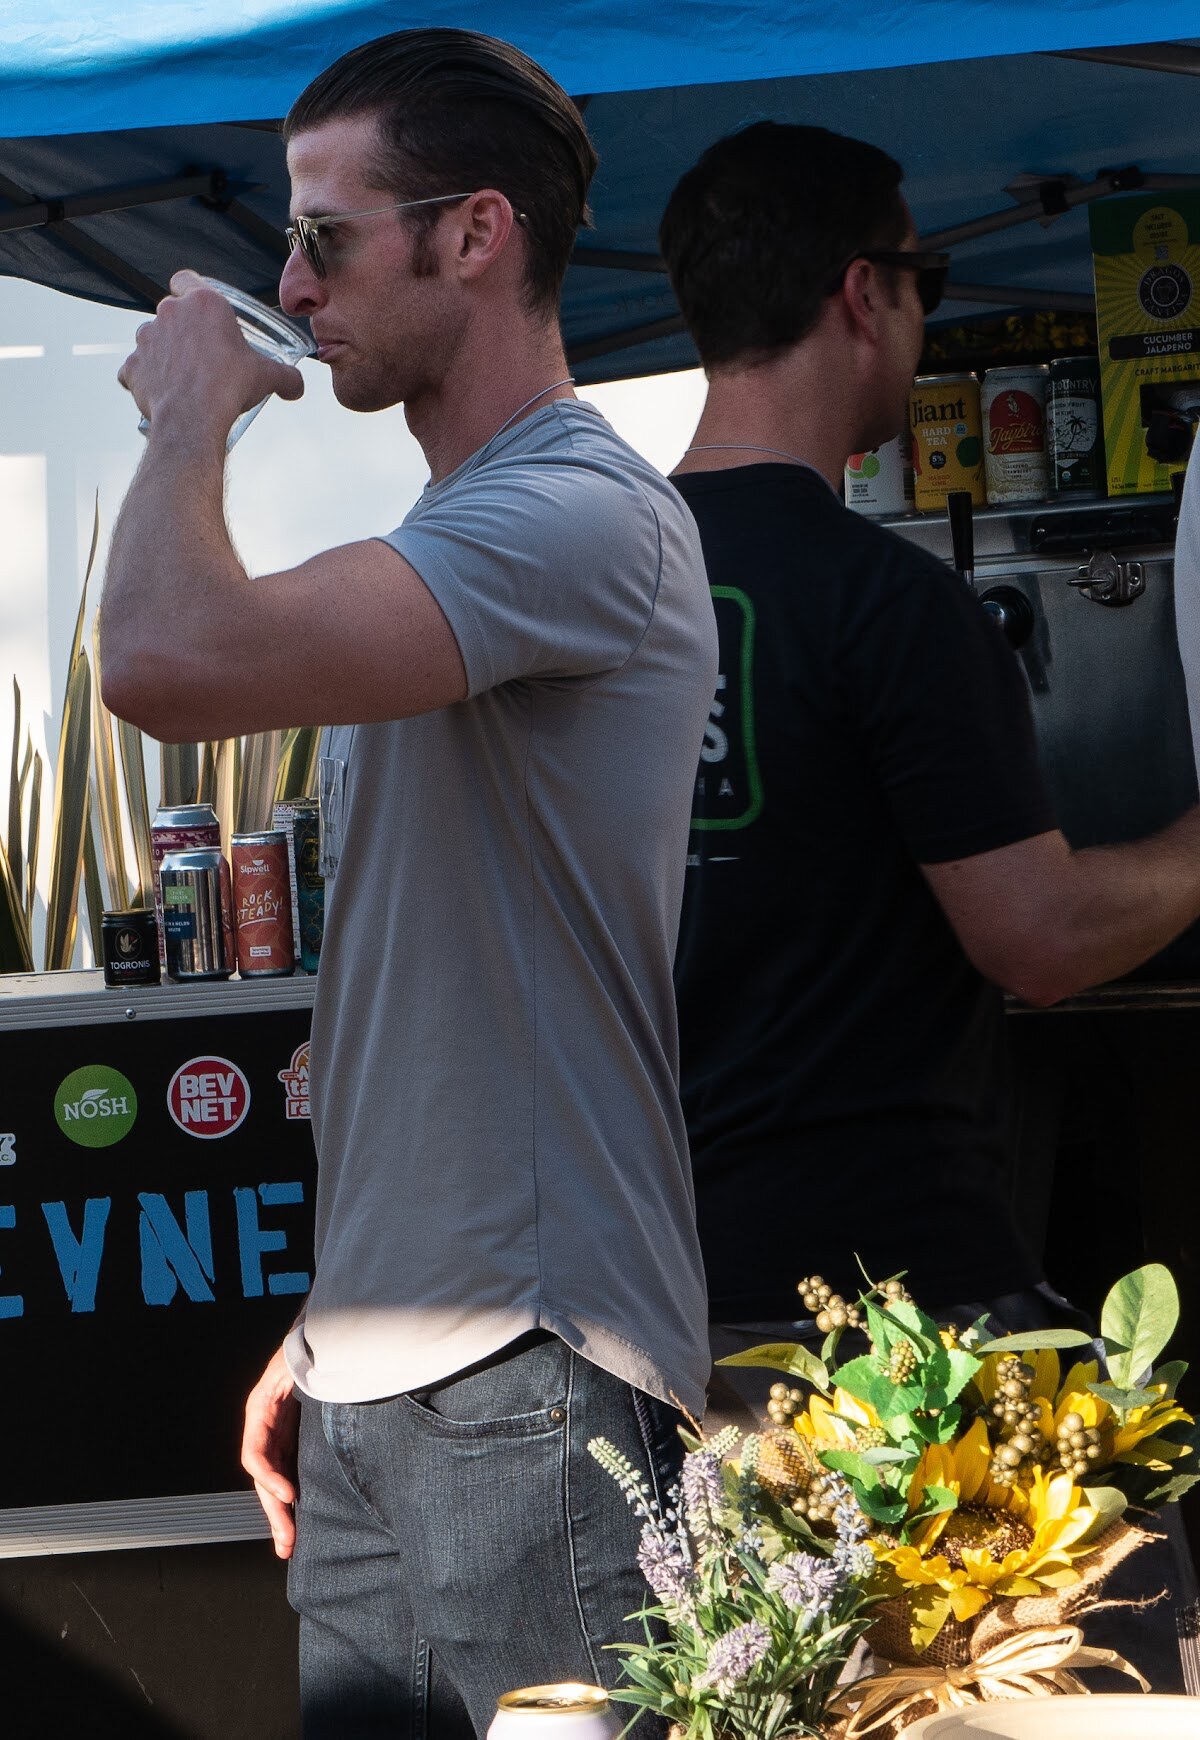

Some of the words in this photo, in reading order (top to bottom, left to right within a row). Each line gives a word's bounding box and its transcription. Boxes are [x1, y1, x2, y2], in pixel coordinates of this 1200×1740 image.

[1143, 332, 1193, 345] CUCUMBER
[1135, 366, 1159, 376] CRAFT
[1160, 363, 1200, 374] MARGARIT
[911, 398, 967, 428] Jiant
[921, 427, 951, 437] HARD
[926, 437, 948, 446] TEA
[242, 889, 272, 907] ROCK
[110, 960, 151, 970] TOGRONIS
[179, 1072, 236, 1099] BEV
[63, 1096, 130, 1121] NOSH
[180, 1097, 236, 1124] NET
